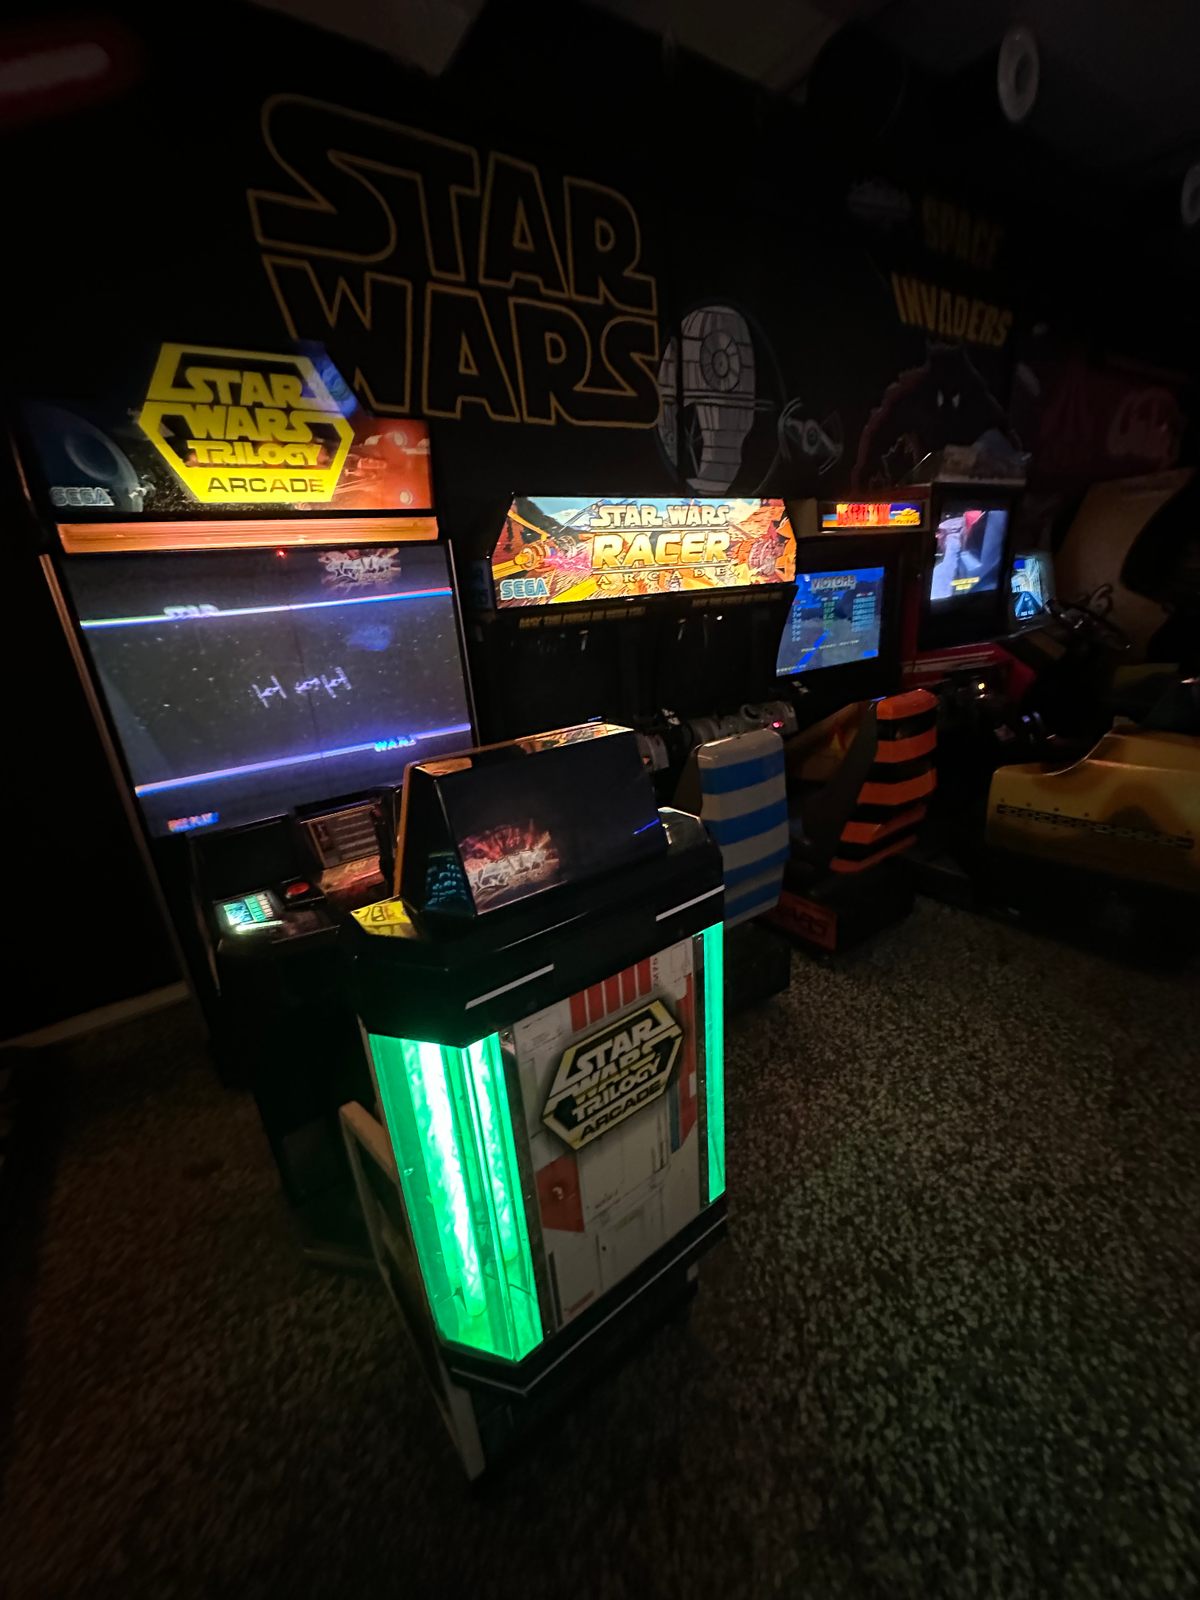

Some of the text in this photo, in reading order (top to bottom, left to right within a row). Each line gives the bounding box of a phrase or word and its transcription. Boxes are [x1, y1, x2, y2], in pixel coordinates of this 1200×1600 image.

[246, 93, 658, 315] STAR
[891, 271, 1014, 348] INVADERS
[262, 253, 660, 429] WARS
[182, 367, 303, 408] STAR
[190, 404, 313, 444] WARS
[187, 439, 322, 467] TRILOGY
[50, 486, 114, 507] SEGA
[207, 476, 325, 494] ARCADE
[590, 504, 730, 527] STAR WARS
[591, 531, 731, 569] RACER
[501, 578, 549, 600] SEGA
[597, 566, 727, 586] ARCADE
[572, 1018, 655, 1075] STAR
[573, 1043, 661, 1105] WARS
[573, 1057, 661, 1122] TRILOGY
[581, 1079, 663, 1140] ARCADE
